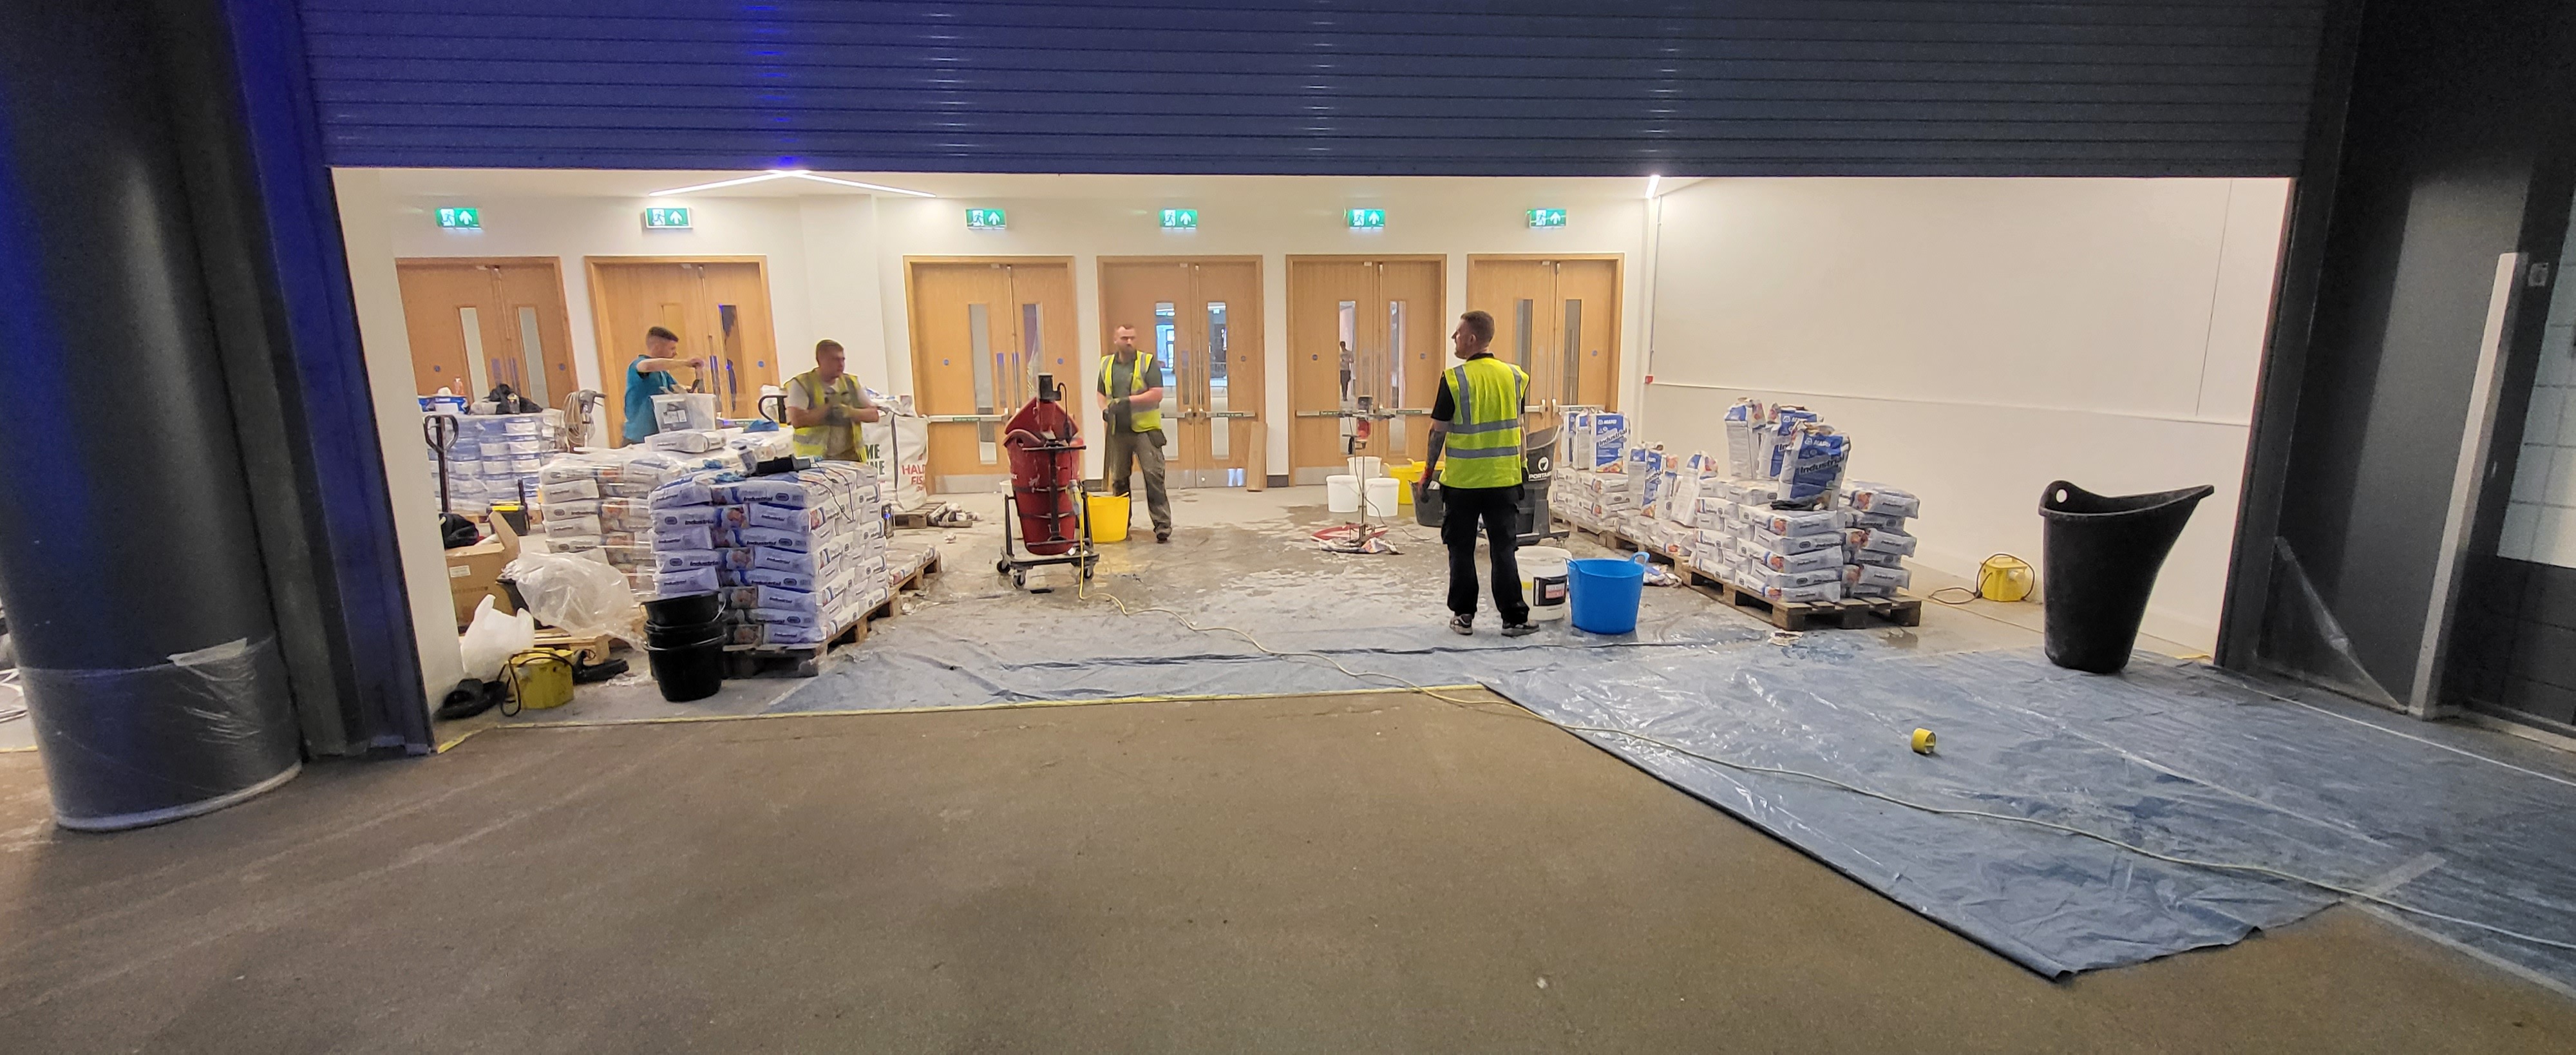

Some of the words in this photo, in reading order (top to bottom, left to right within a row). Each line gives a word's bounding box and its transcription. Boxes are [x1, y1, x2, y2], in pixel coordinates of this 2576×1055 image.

[1599, 427, 1627, 446] Industrial
[865, 444, 880, 459] ME
[1801, 452, 1845, 473] Industrial
